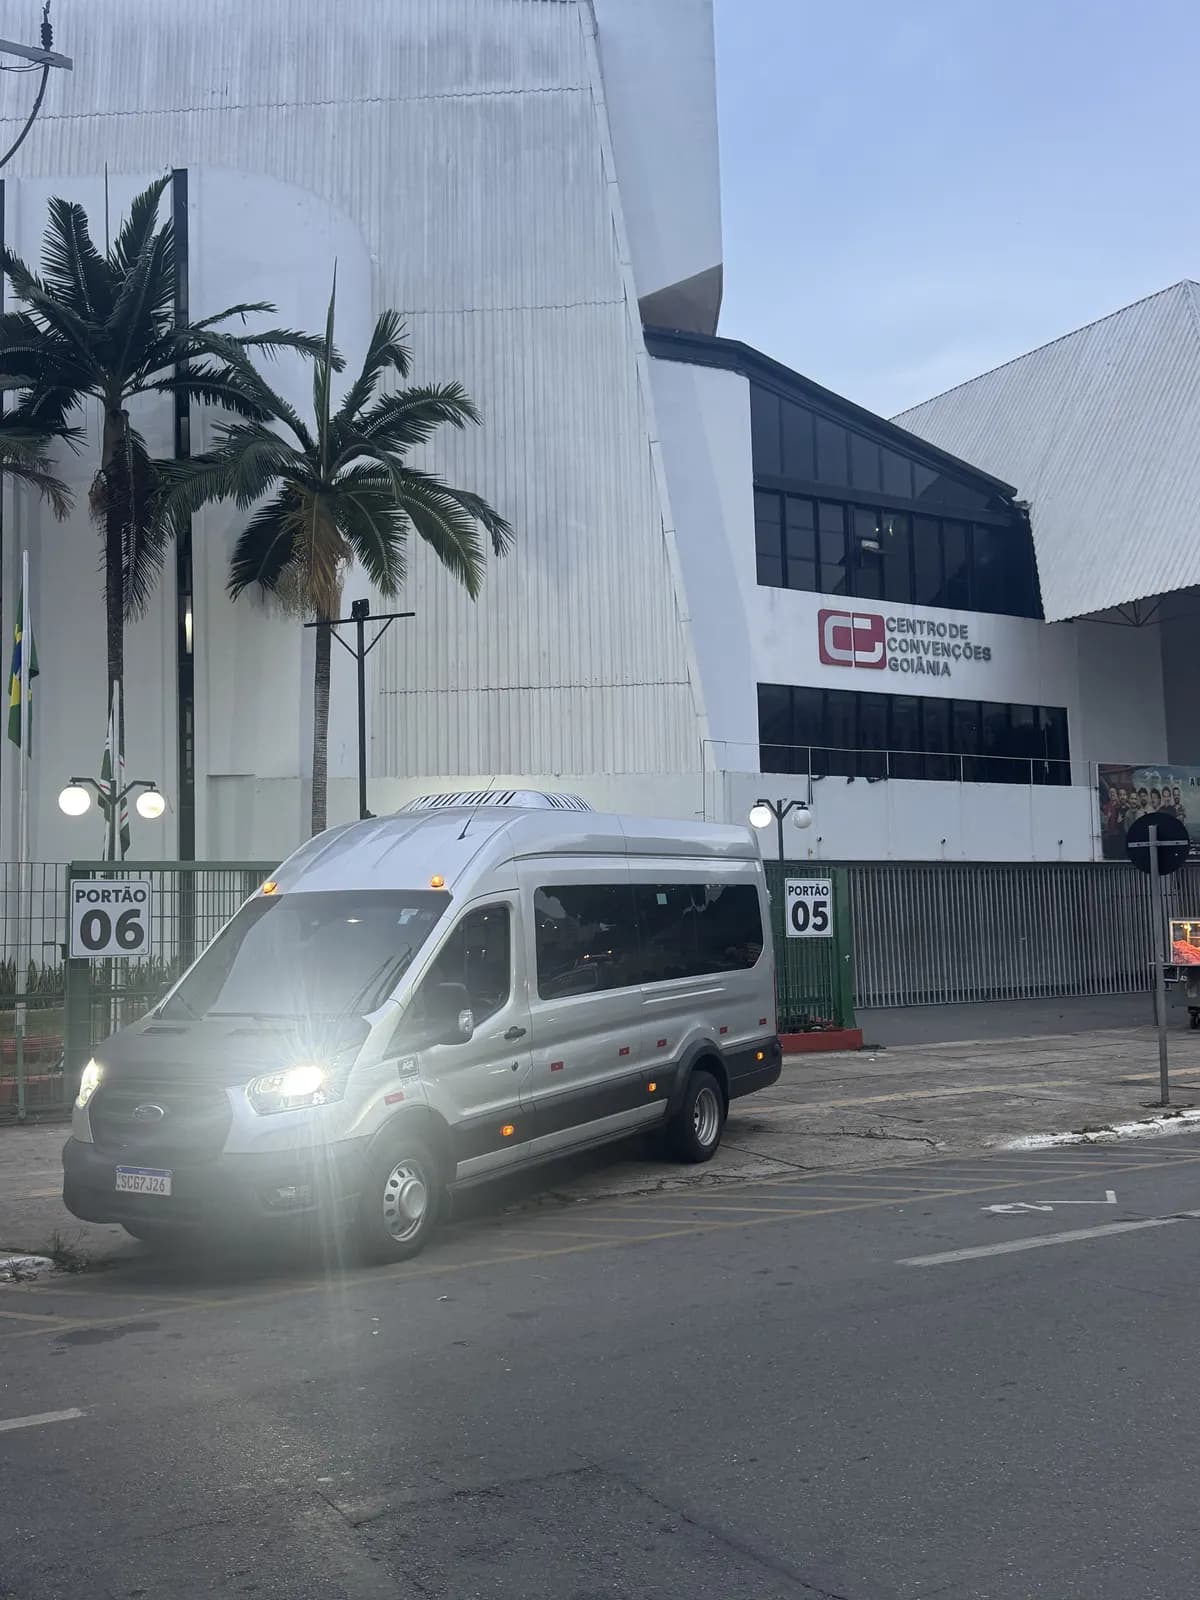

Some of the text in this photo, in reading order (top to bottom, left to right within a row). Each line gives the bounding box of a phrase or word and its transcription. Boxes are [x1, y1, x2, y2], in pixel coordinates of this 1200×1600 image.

[886, 617, 969, 640] CENTRO DE
[887, 637, 992, 662] CONVENÇÕES
[75, 886, 147, 903] PORTÃO
[788, 883, 829, 896] PORTÃO
[791, 900, 829, 932] 05
[80, 909, 145, 950] 06
